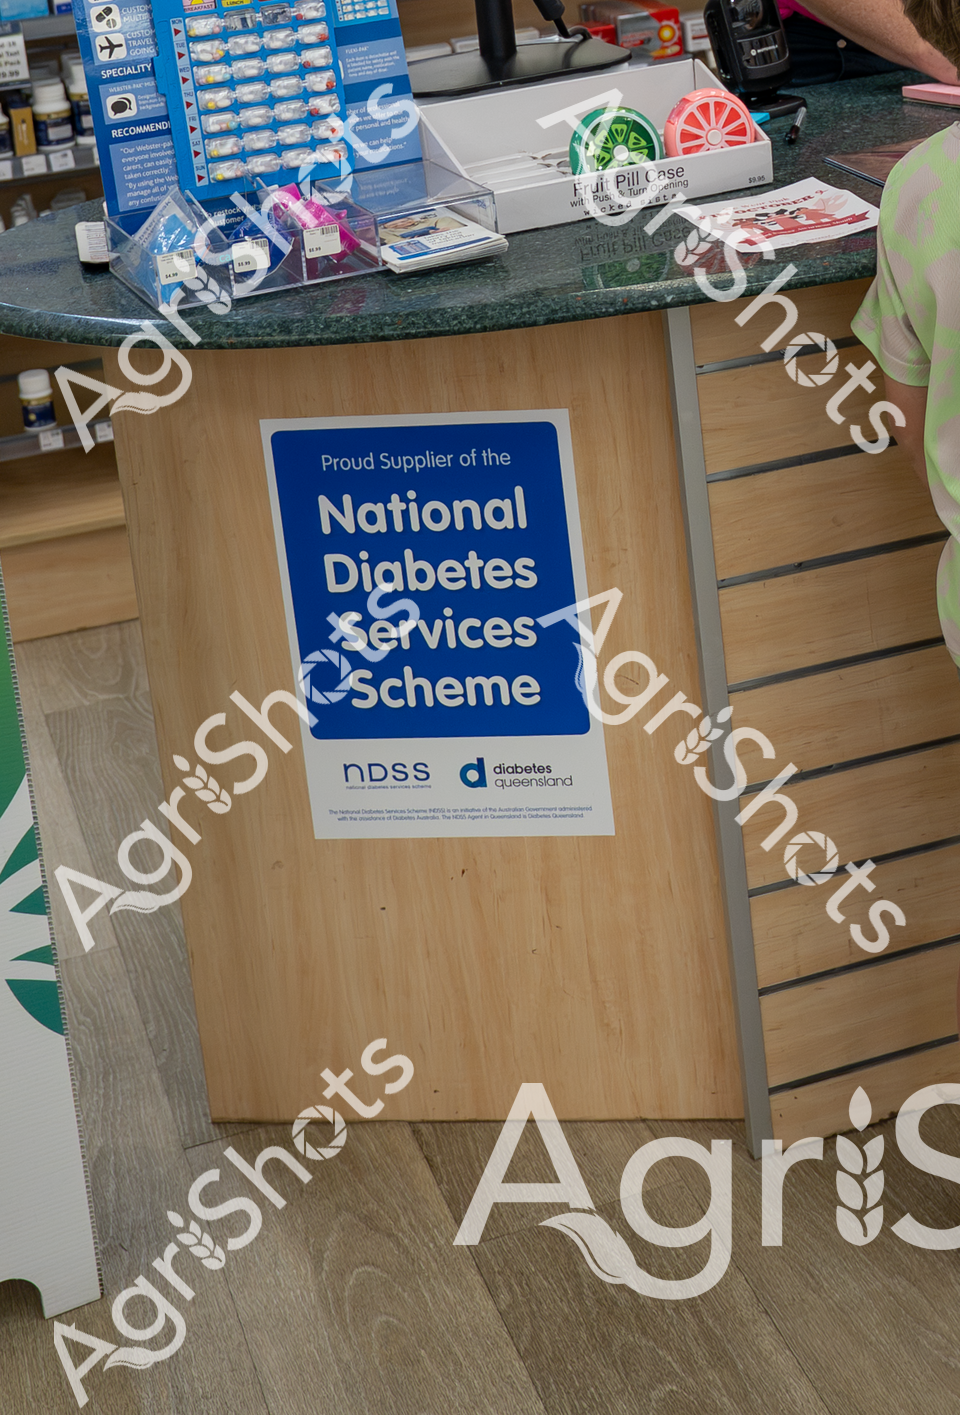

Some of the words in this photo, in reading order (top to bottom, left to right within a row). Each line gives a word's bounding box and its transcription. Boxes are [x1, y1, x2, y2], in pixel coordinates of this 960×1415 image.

[184, 3, 213, 12] BREAKFAST
[128, 38, 153, 47] TRAVEL
[130, 46, 155, 56] GOING
[101, 63, 152, 78] SPECIALITY
[355, 121, 379, 132] personal
[380, 118, 391, 127] and
[369, 139, 379, 147] can
[122, 153, 149, 163] everyone
[123, 163, 143, 172] carers,
[155, 158, 172, 168] easily
[124, 172, 141, 180] taken
[138, 179, 153, 188] using
[154, 176, 164, 184] the
[573, 177, 611, 197] Fruit
[616, 171, 639, 189] Pill
[645, 166, 684, 183] Case
[748, 175, 765, 183] $9.95
[127, 189, 151, 199] manage
[570, 197, 589, 207] with
[593, 192, 615, 203] Push
[628, 187, 647, 197] Turn
[650, 179, 688, 192] Opening
[128, 198, 139, 206] any
[583, 201, 632, 216] wicked
[735, 196, 815, 214] OCTOBER
[213, 207, 241, 217] restock
[321, 453, 375, 471] Proud
[380, 451, 454, 472] Supplier
[460, 449, 479, 467] of
[482, 449, 511, 466] the
[318, 486, 528, 535] National
[324, 549, 538, 593] Diabetes
[339, 608, 538, 651] Services
[350, 666, 541, 709] Scheme
[493, 763, 552, 774] diabetes
[494, 775, 573, 790] queensland
